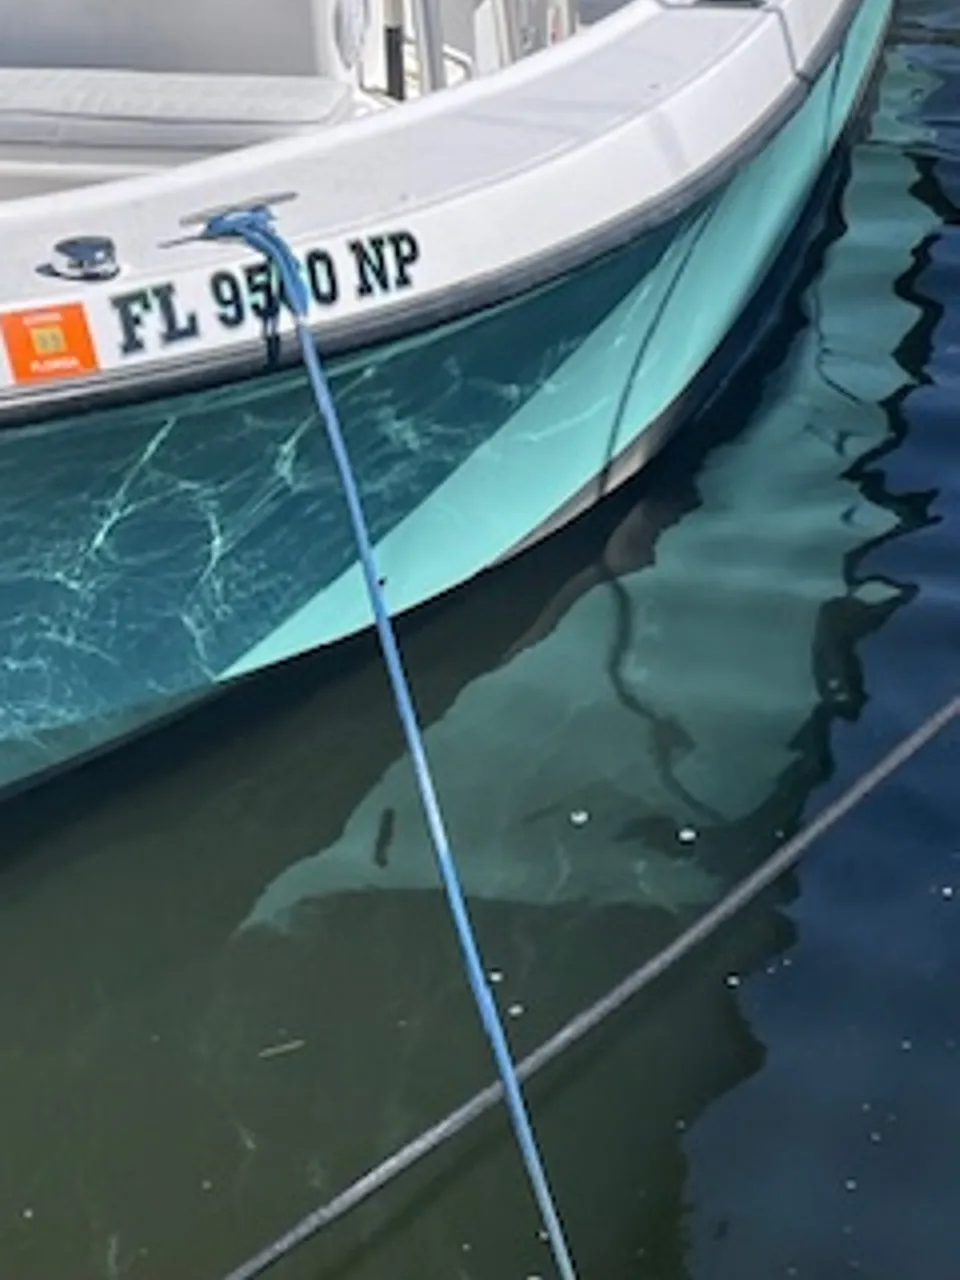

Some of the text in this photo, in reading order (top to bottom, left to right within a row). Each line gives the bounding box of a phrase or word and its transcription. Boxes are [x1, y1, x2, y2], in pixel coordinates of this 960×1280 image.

[109, 231, 419, 354] FL 950 NP
